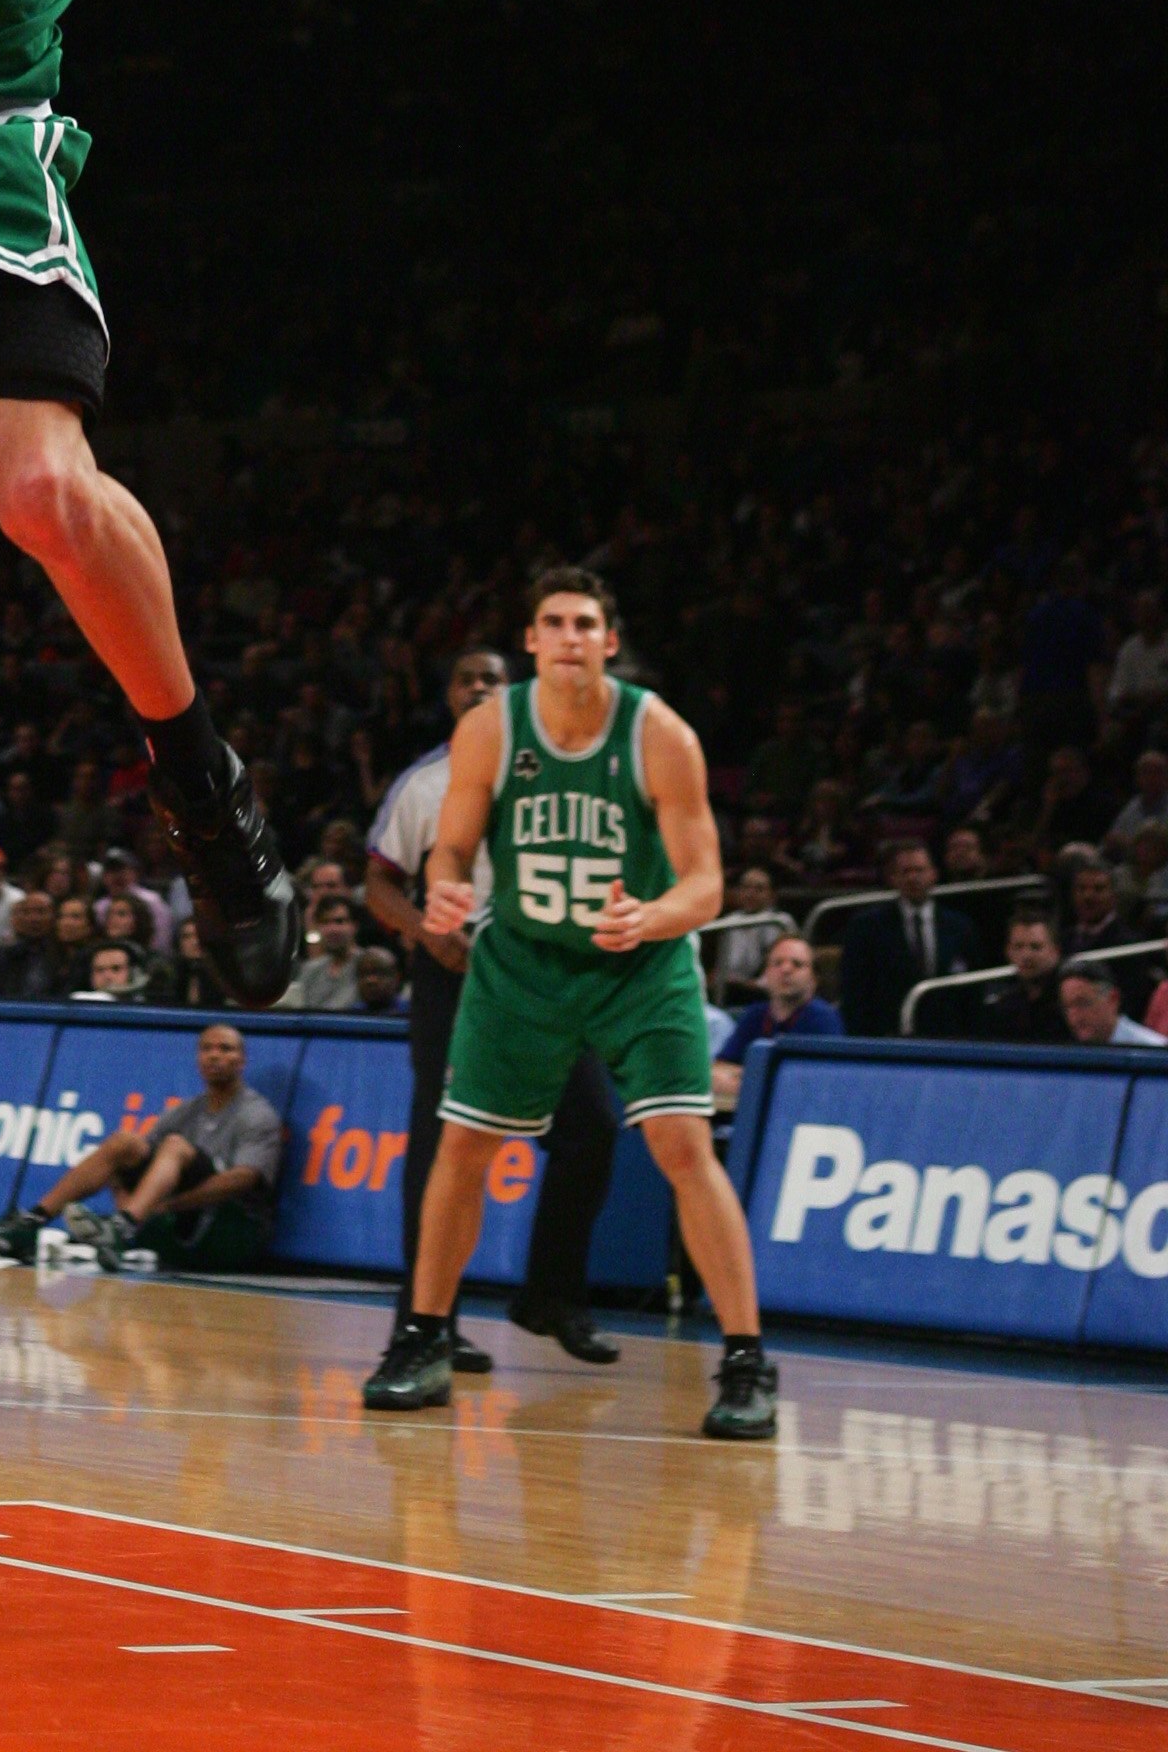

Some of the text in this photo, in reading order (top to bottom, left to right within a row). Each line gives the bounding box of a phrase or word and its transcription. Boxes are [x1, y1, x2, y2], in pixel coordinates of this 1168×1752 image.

[513, 791, 627, 854] CELTICS
[517, 852, 622, 927] 55
[302, 1105, 409, 1192] for
